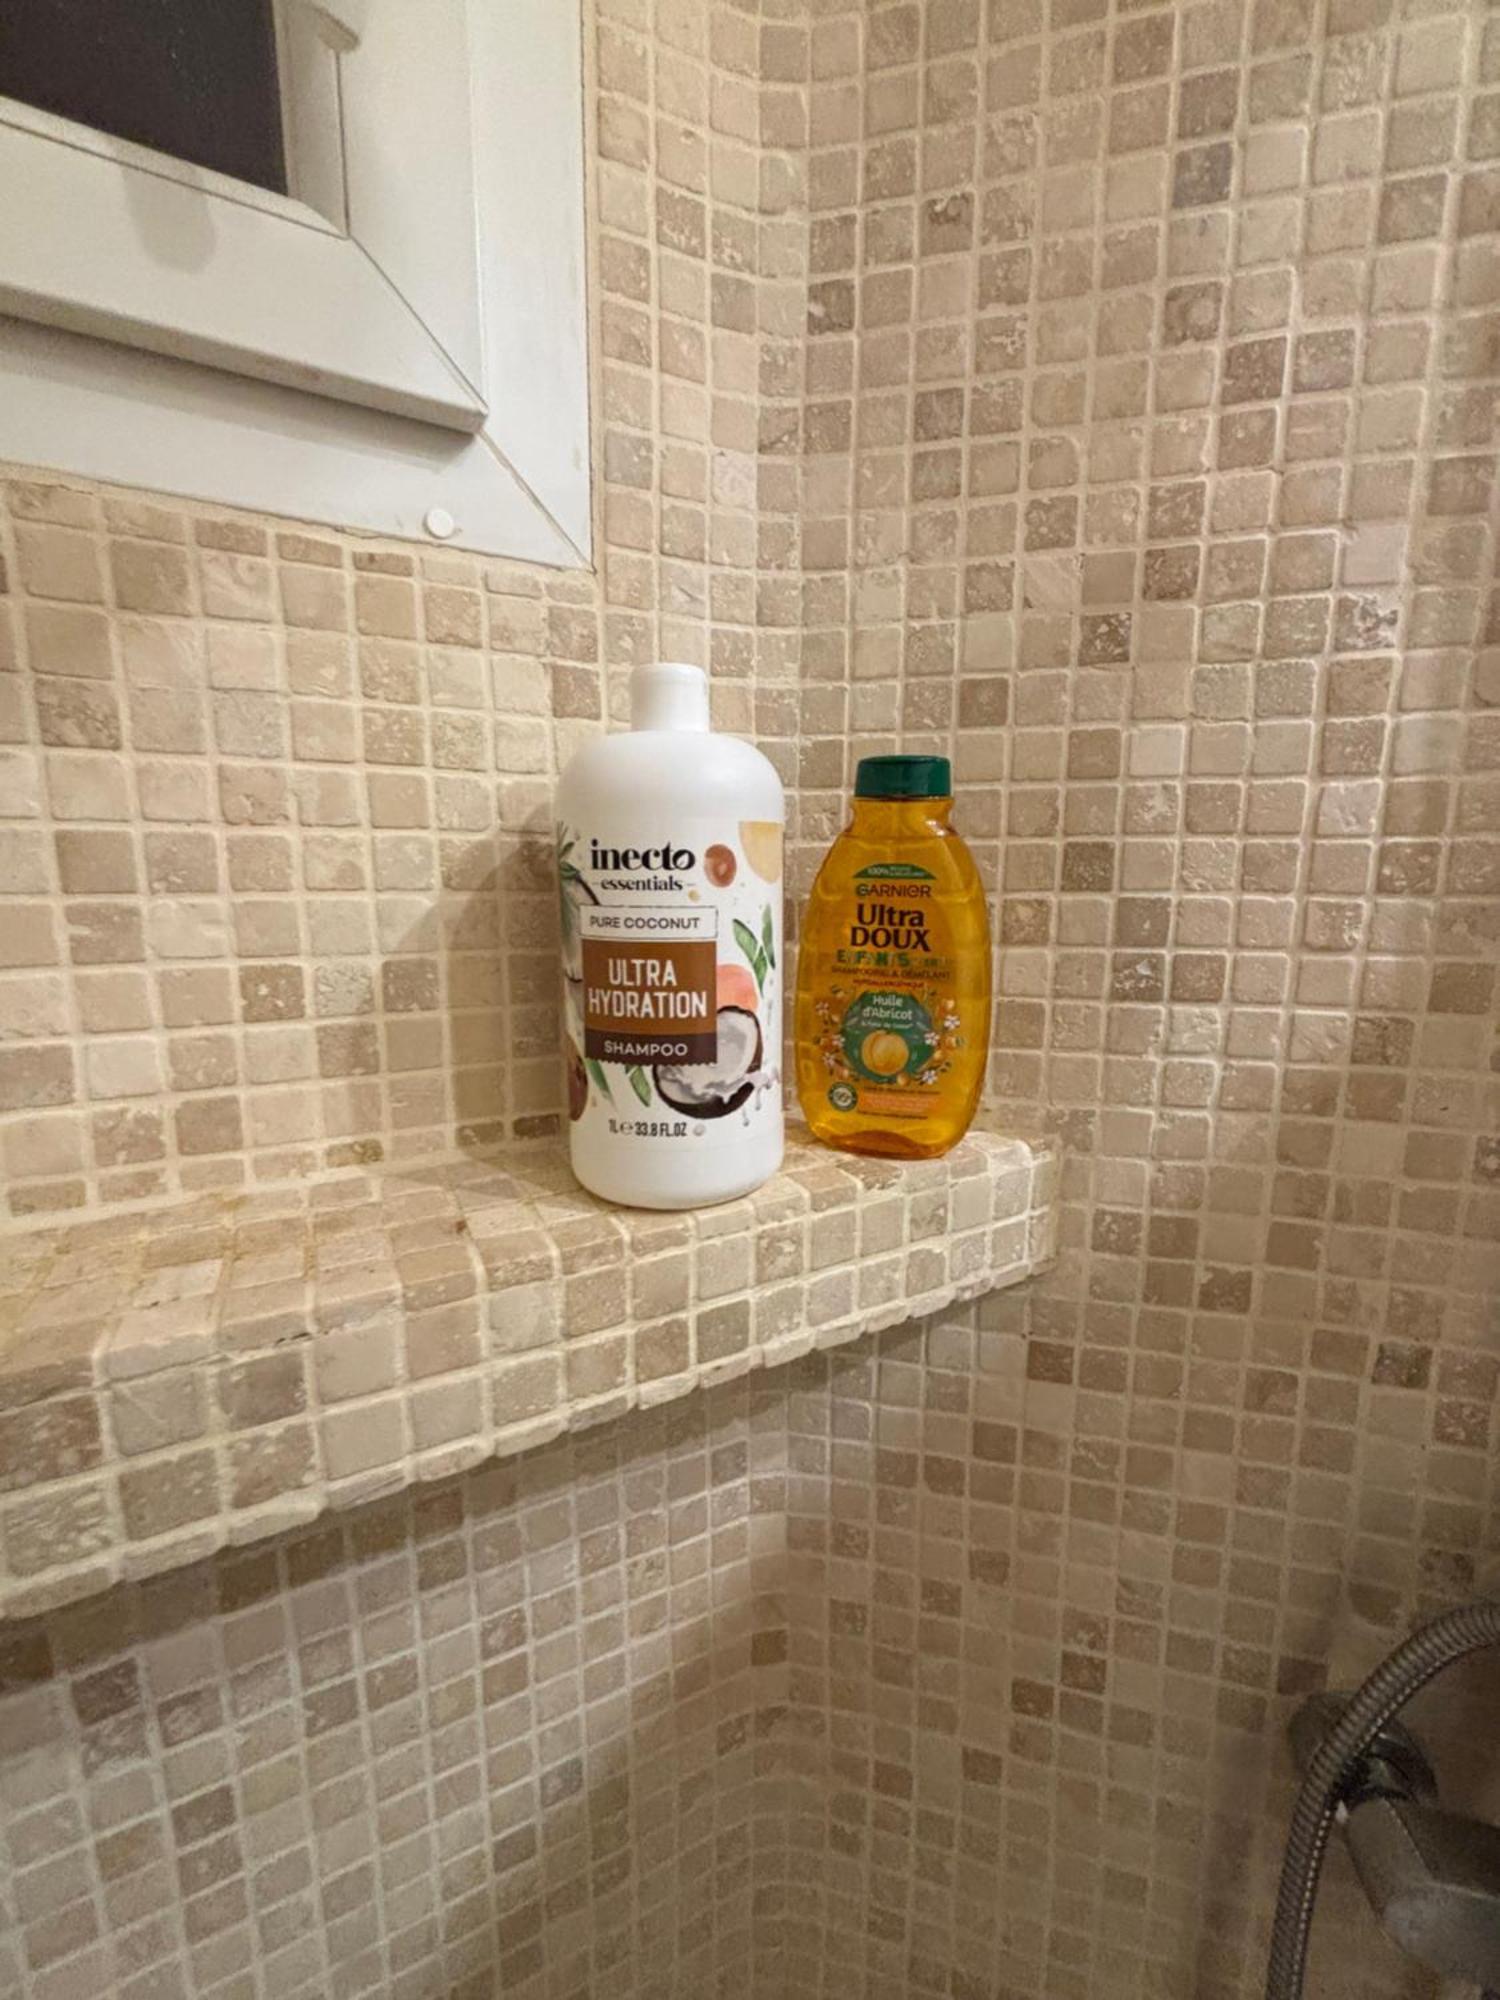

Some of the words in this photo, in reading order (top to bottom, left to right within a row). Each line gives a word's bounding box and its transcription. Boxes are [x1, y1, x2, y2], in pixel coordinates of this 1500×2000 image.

[591, 838, 696, 871] inecto
[601, 875, 683, 892] essentials
[856, 883, 931, 898] GARNIER
[590, 916, 621, 929] PURE
[623, 917, 701, 930] COCONUT
[857, 903, 925, 927] Ultra
[851, 926, 932, 952] DOUX
[608, 958, 678, 987] ULTRA
[588, 988, 708, 1018] HYDRATION
[873, 994, 904, 1007] Huile
[862, 1006, 914, 1021] d'Abricot
[604, 1040, 689, 1057] SHAMPOO
[634, 1121, 658, 1137] 33.8
